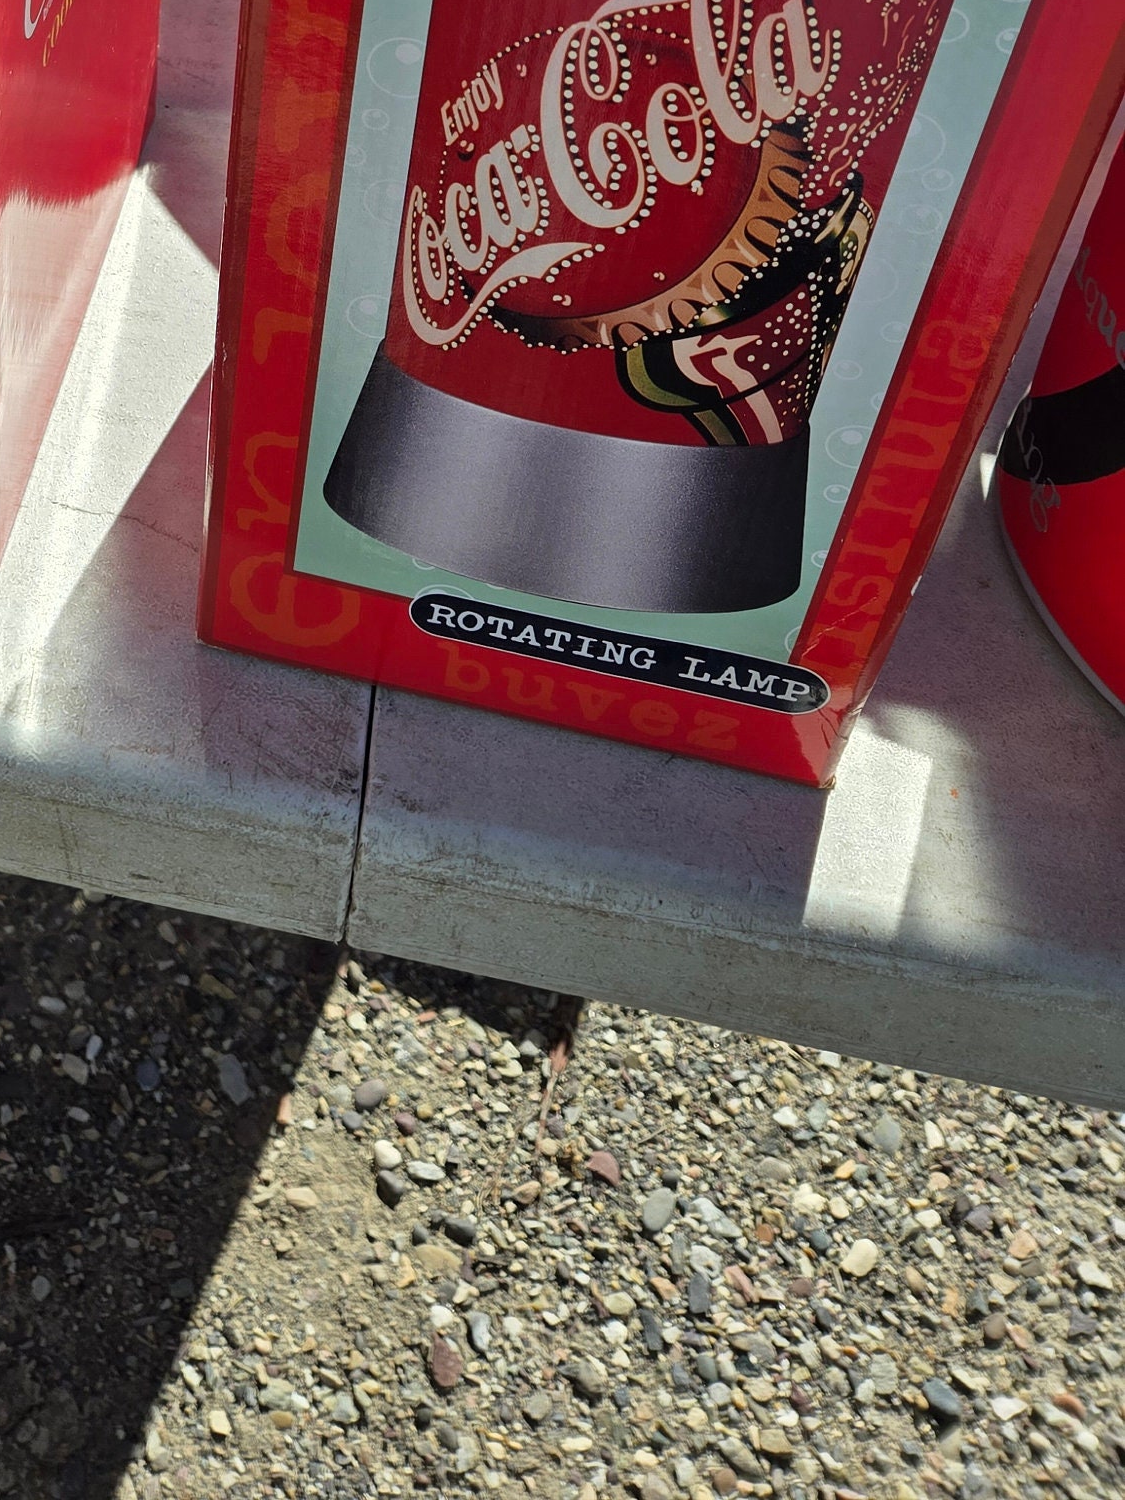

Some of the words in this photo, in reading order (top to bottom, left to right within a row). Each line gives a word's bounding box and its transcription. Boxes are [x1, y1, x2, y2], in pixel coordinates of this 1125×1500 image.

[439, 60, 506, 146] Enjoy
[426, 602, 658, 671] ROTATING
[678, 655, 814, 704] LAMP
[436, 639, 743, 751] buvez
